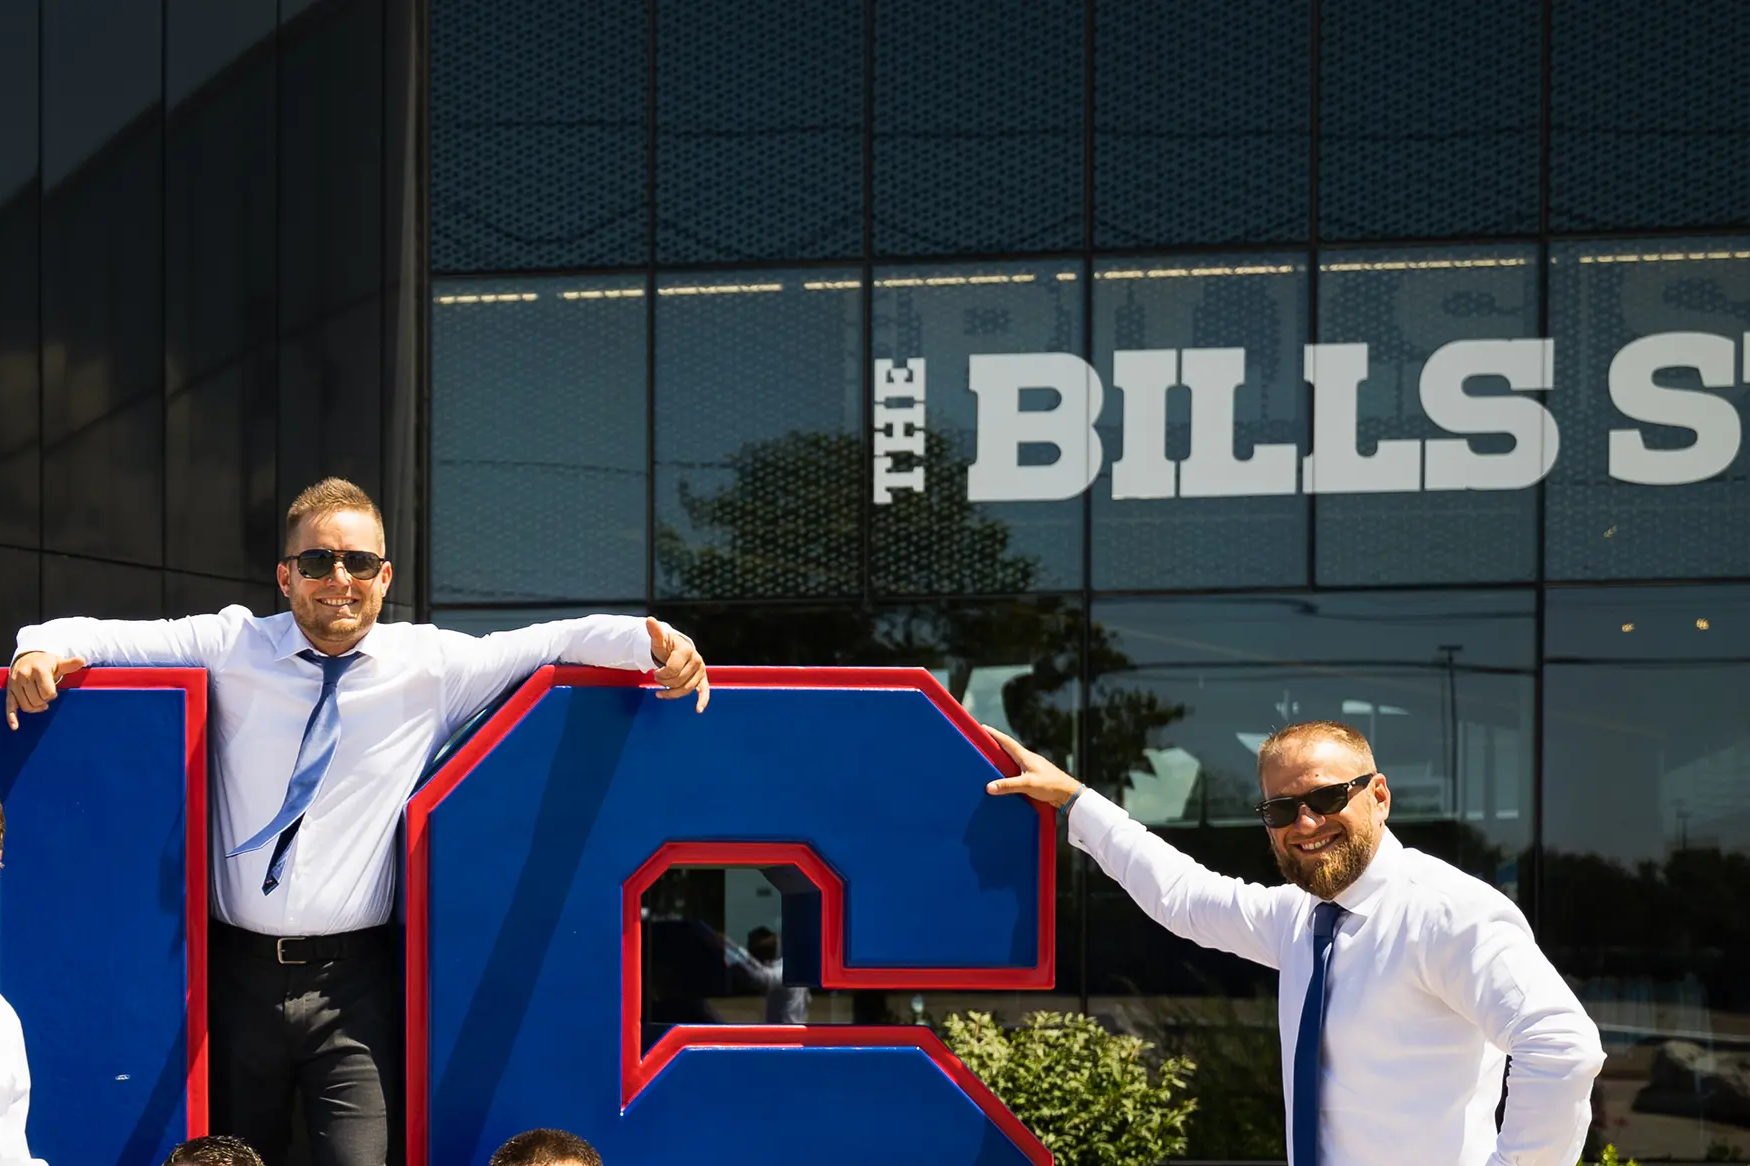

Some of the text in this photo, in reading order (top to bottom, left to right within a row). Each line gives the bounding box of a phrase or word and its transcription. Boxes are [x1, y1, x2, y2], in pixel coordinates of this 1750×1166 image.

[873, 357, 926, 504] THE
[967, 331, 1750, 503] BILLS S
